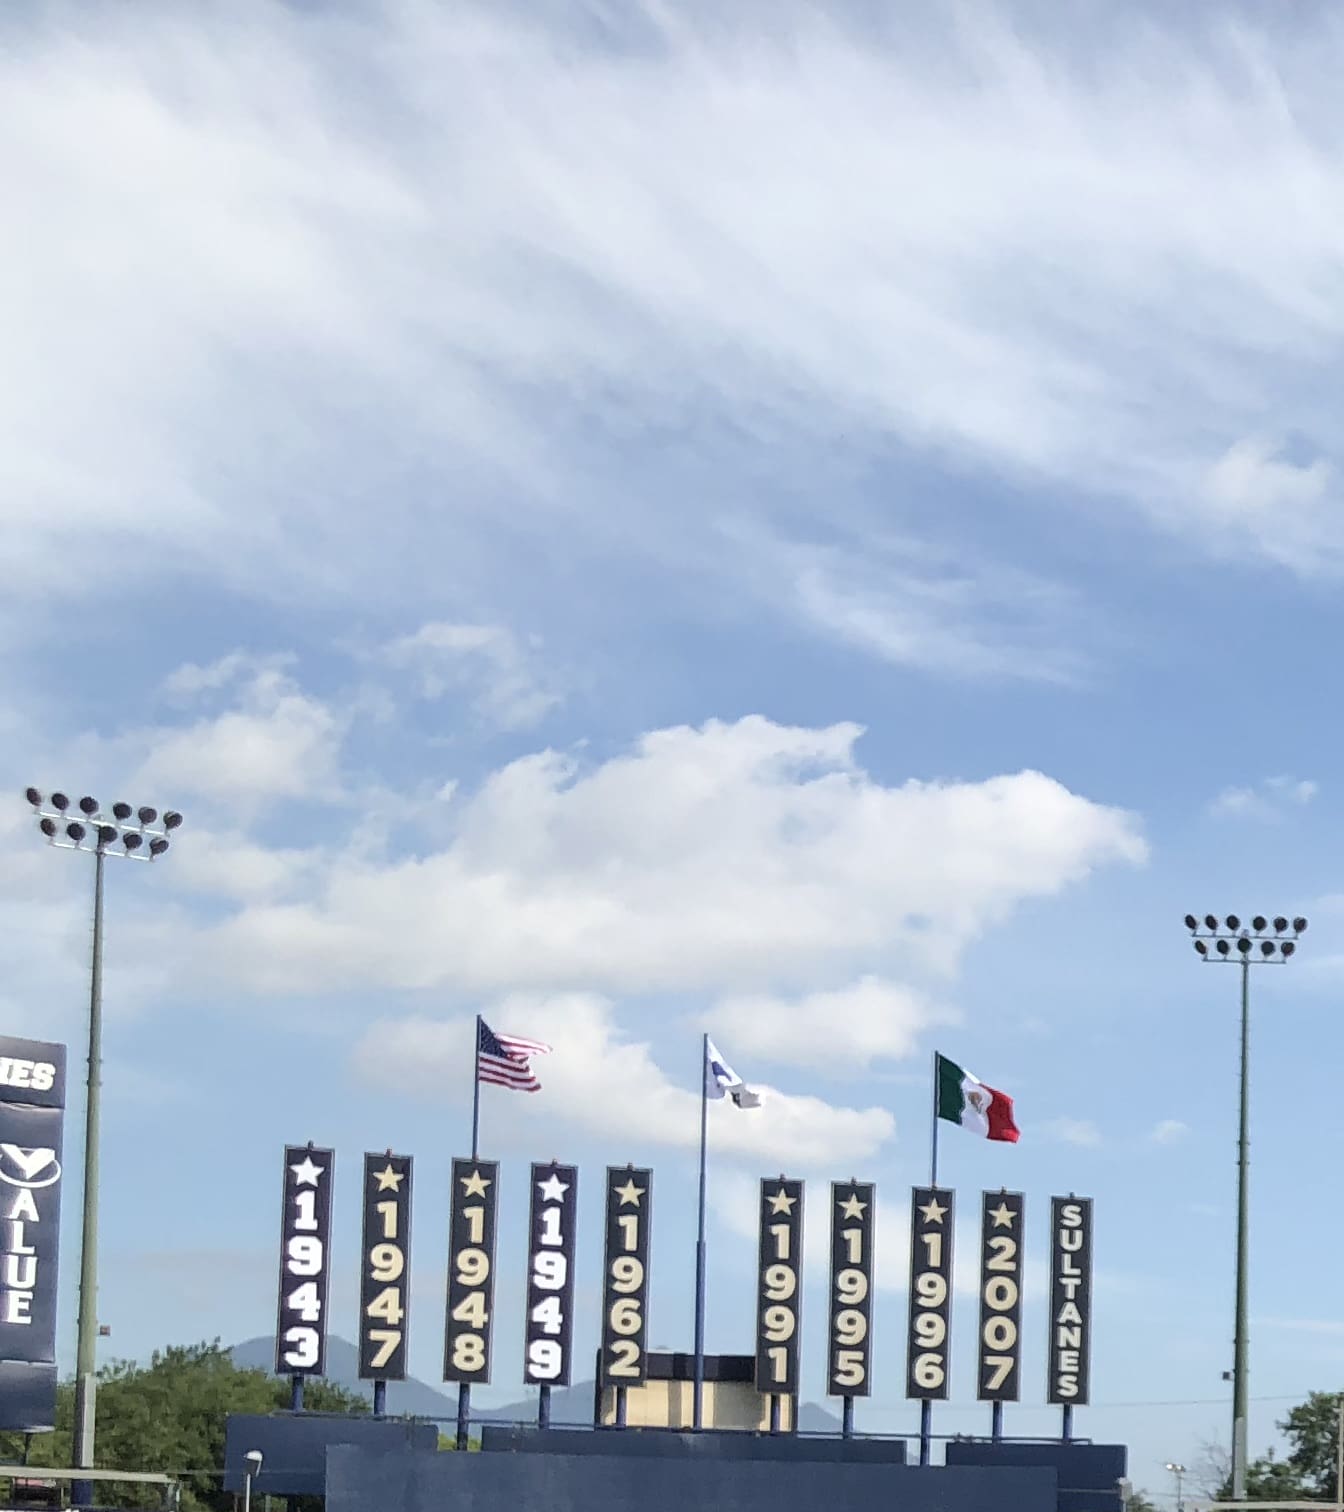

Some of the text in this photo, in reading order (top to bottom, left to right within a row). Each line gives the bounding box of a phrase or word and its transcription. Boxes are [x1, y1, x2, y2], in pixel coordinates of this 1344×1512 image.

[285, 1190, 323, 1368] 1943
[367, 1200, 404, 1369] 1947
[452, 1206, 489, 1373] 1948
[528, 1206, 567, 1380] 1949
[608, 1214, 645, 1378] 1962
[764, 1223, 797, 1383] 1991
[833, 1228, 869, 1387] 1995
[914, 1232, 948, 1389] 1996
[983, 1236, 1018, 1391] 2007
[1057, 1204, 1084, 1398] SULTANES
